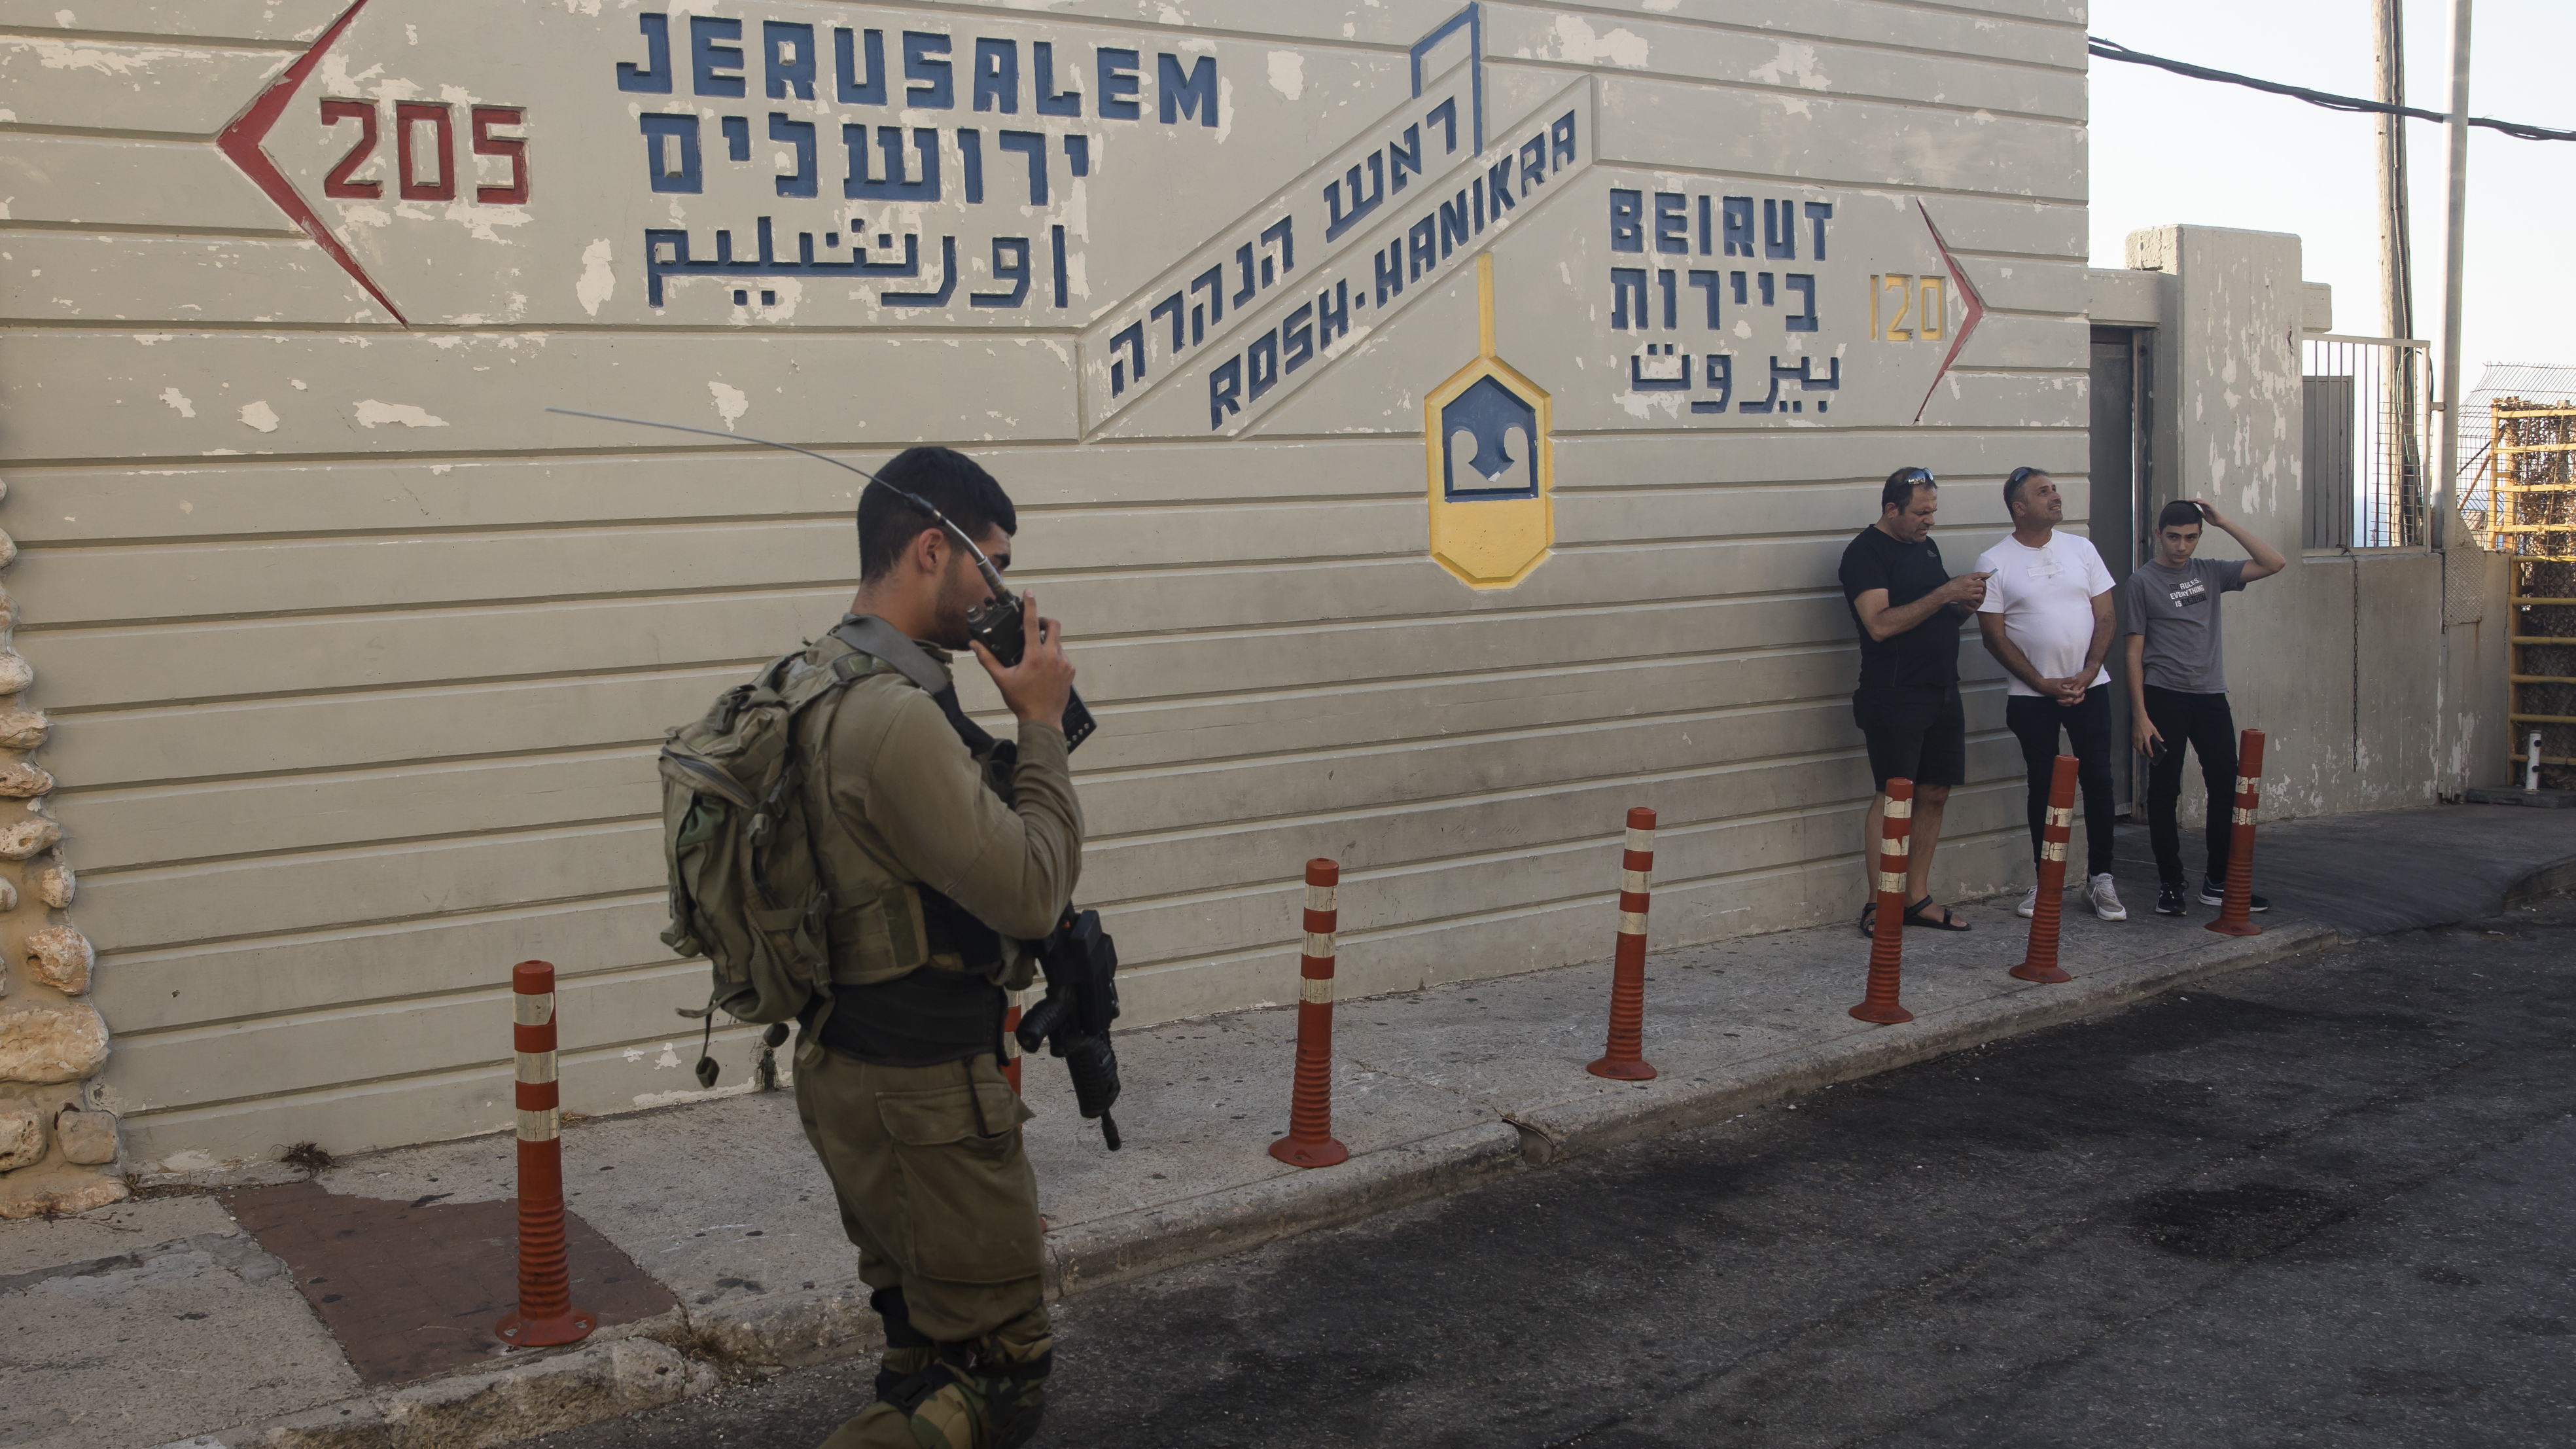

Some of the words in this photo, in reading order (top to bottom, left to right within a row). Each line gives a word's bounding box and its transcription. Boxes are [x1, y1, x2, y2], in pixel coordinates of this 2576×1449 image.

[617, 13, 1218, 128] JERUSALEM
[321, 99, 530, 205] 205
[640, 112, 1089, 206] ירושלים
[1324, 96, 1456, 243] ראש
[1610, 188, 1832, 260] BEIRUT
[1110, 215, 1294, 399] הנקרה
[1610, 268, 1818, 332] ביירות
[1870, 274, 1946, 341] 120
[1631, 344, 1839, 414] بيروت
[2170, 584, 2205, 599] EVERYTHING
[2179, 578, 2201, 590] RULES.
[2183, 594, 2206, 606] ALRIGHT
